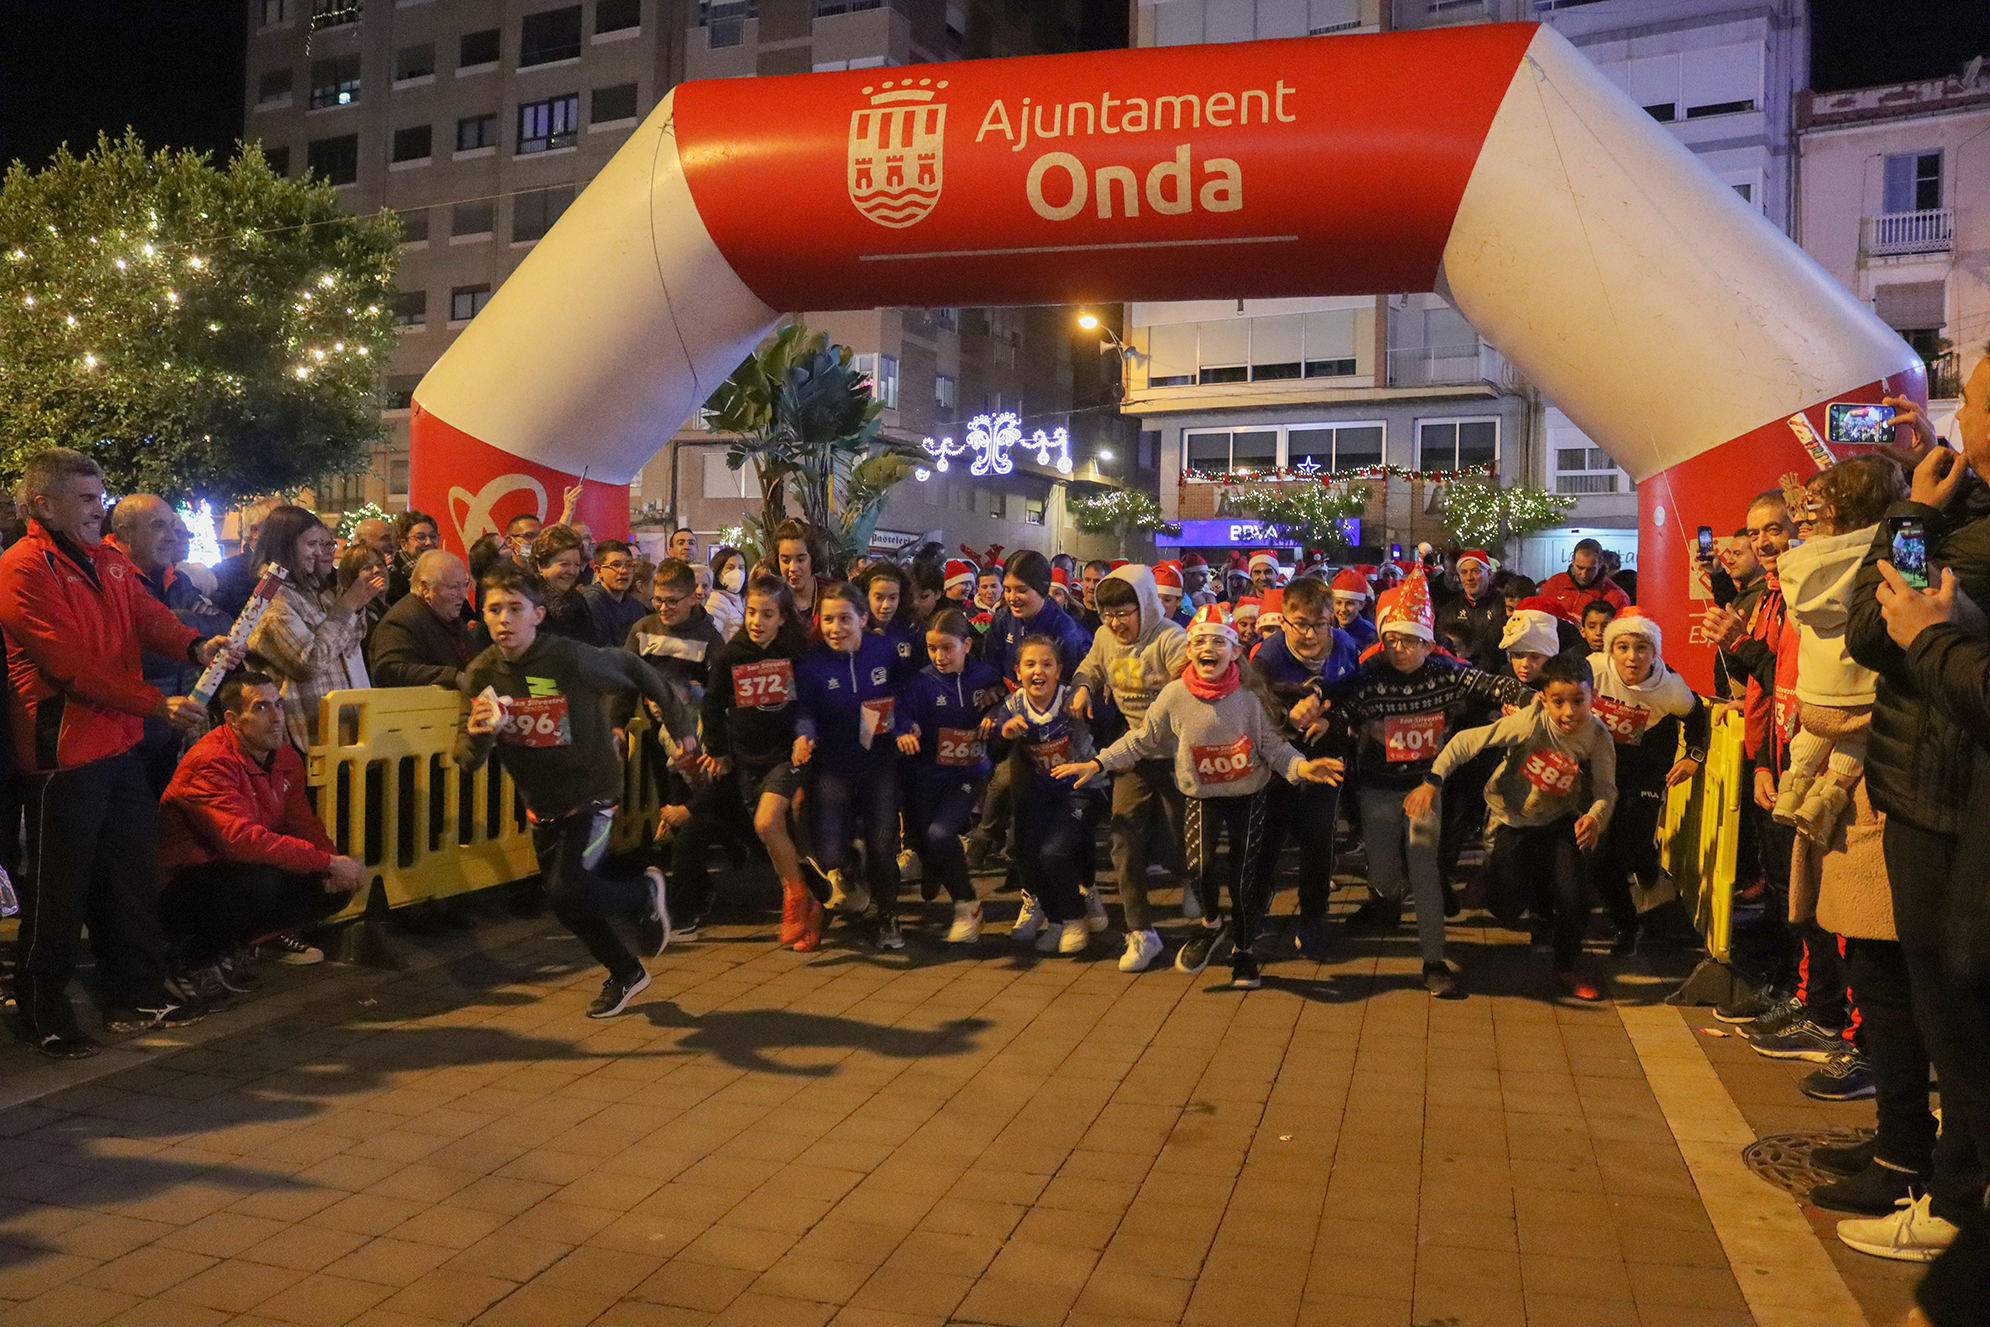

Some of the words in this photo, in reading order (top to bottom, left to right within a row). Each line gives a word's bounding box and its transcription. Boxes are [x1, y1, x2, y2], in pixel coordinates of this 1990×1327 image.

[975, 79, 1297, 152] Ajuntament
[1026, 143, 1244, 221] Onda
[738, 674, 782, 697] 372
[527, 698, 565, 707] Silvestre
[1604, 701, 1617, 709] San
[1618, 705, 1649, 716] Silvestre
[502, 713, 555, 736] 396
[1415, 714, 1444, 722] Silvestre
[1389, 728, 1434, 750] 401
[1198, 753, 1248, 775] 400
[1526, 755, 1575, 790] 388
[1640, 790, 1660, 799] FILA
